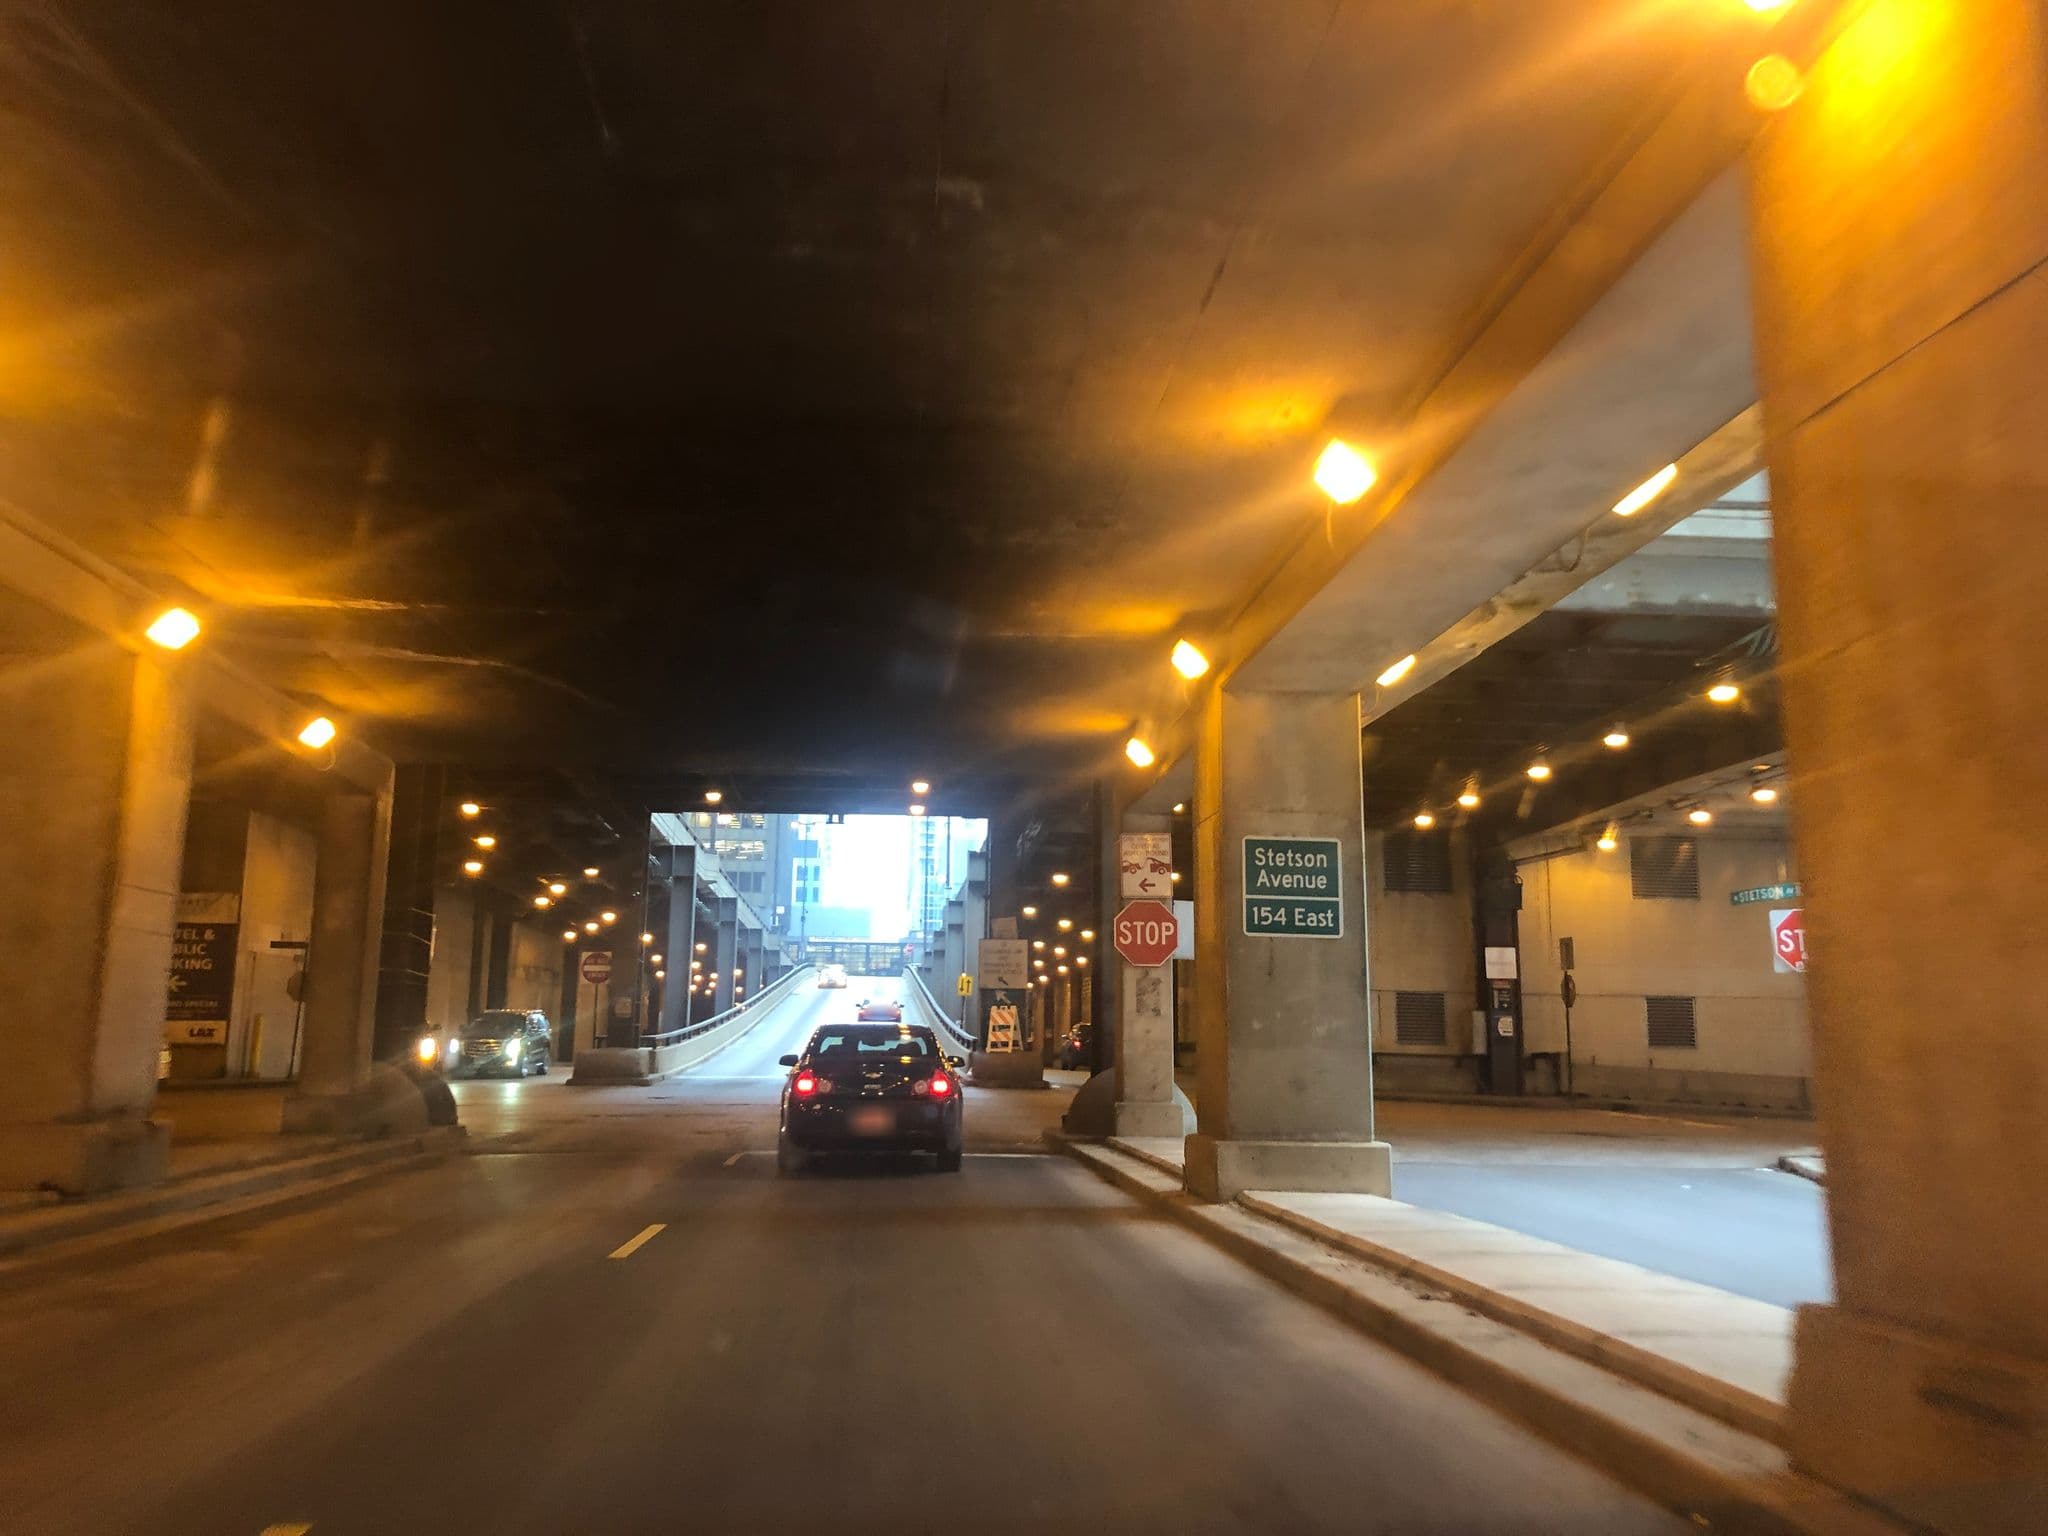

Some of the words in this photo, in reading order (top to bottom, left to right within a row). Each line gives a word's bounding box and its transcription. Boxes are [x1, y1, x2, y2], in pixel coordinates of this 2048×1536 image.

[1255, 847, 1327, 868] Stetson
[1256, 868, 1327, 889] Avenue
[1739, 886, 1784, 903] STETSON
[1252, 906, 1287, 926] 154
[1294, 908, 1334, 927] East
[204, 928, 216, 940] &
[1119, 920, 1175, 946] STOP
[1779, 928, 1806, 953] ST
[173, 959, 213, 970] KING
